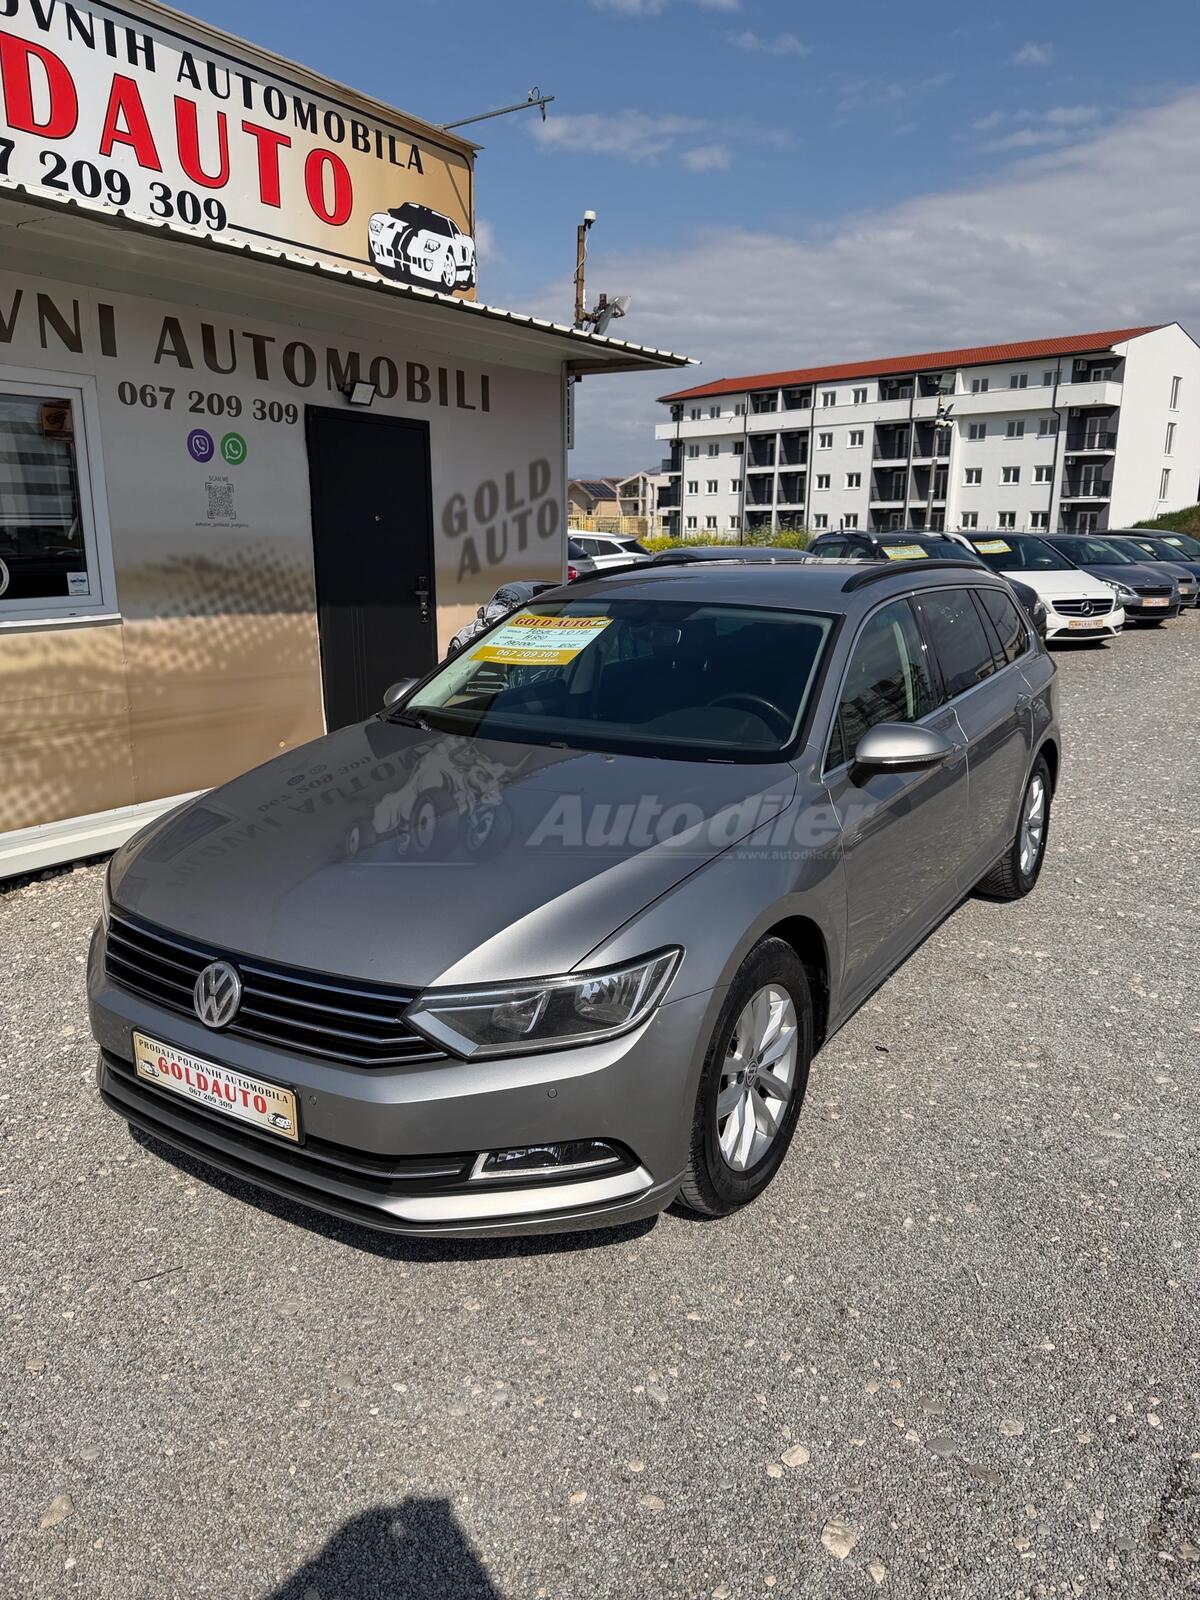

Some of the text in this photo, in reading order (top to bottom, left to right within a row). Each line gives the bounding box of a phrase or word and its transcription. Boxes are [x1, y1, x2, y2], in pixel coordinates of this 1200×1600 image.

[0, 30, 353, 226] DAUTO
[177, 51, 424, 175] AUTOMOBILA
[39, 151, 131, 206] 209
[149, 182, 227, 231] 309
[118, 381, 298, 424] 067 209 309
[154, 316, 490, 412] AUTOMOBILI
[442, 458, 551, 539] GOLD
[457, 498, 559, 584] AUTO
[514, 617, 592, 628] GOLD AUTO
[138, 1038, 289, 1104] PRODAJA POLOVNIH AUTOMOBILA
[157, 1055, 268, 1115] GOLDAUTO
[188, 1086, 202, 1098] 067
[218, 1098, 233, 1110] 309
